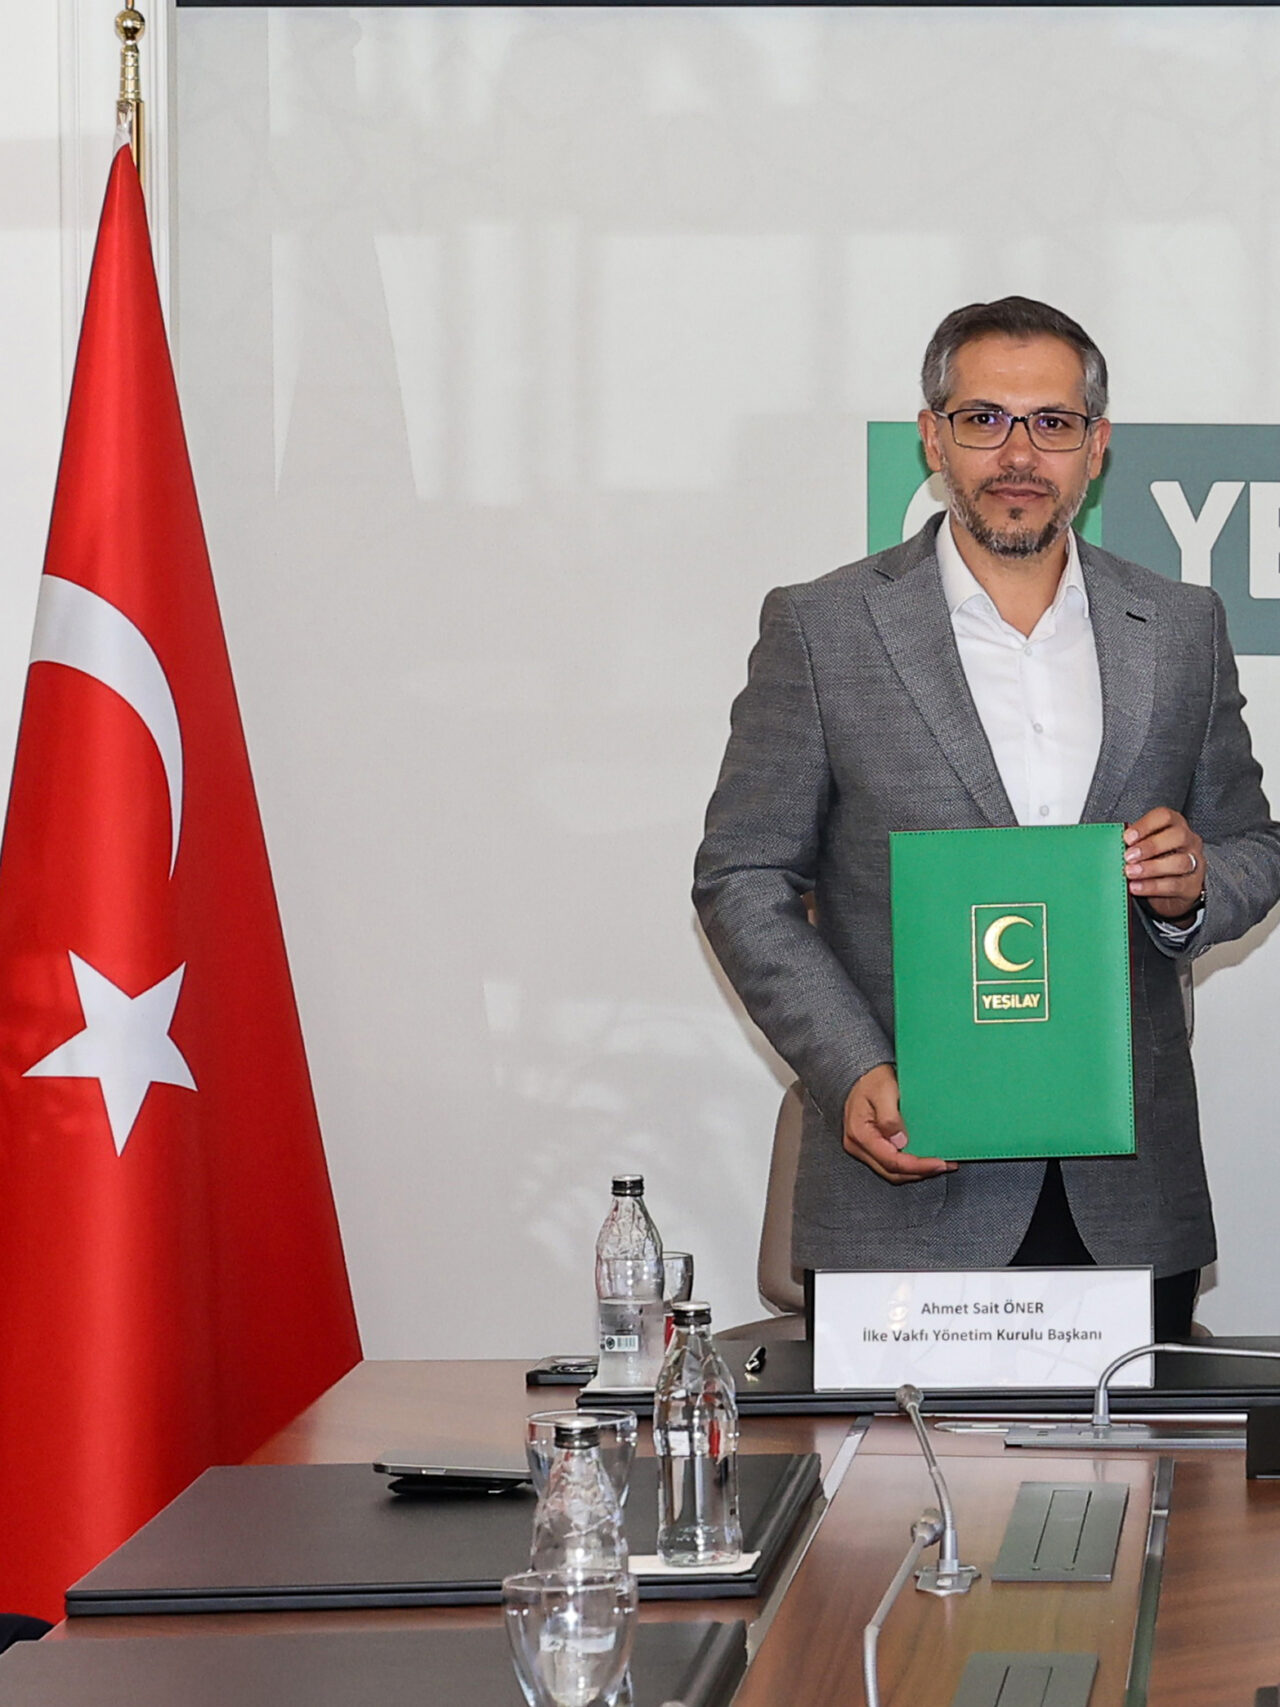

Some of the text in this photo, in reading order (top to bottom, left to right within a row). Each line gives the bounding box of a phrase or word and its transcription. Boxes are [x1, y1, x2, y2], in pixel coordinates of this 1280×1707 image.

[921, 1299, 1044, 1315] Ahmet Sait ÖNER
[863, 1328, 1102, 1343] İlke Vakfı Yönetim Kurulu Başkanı
